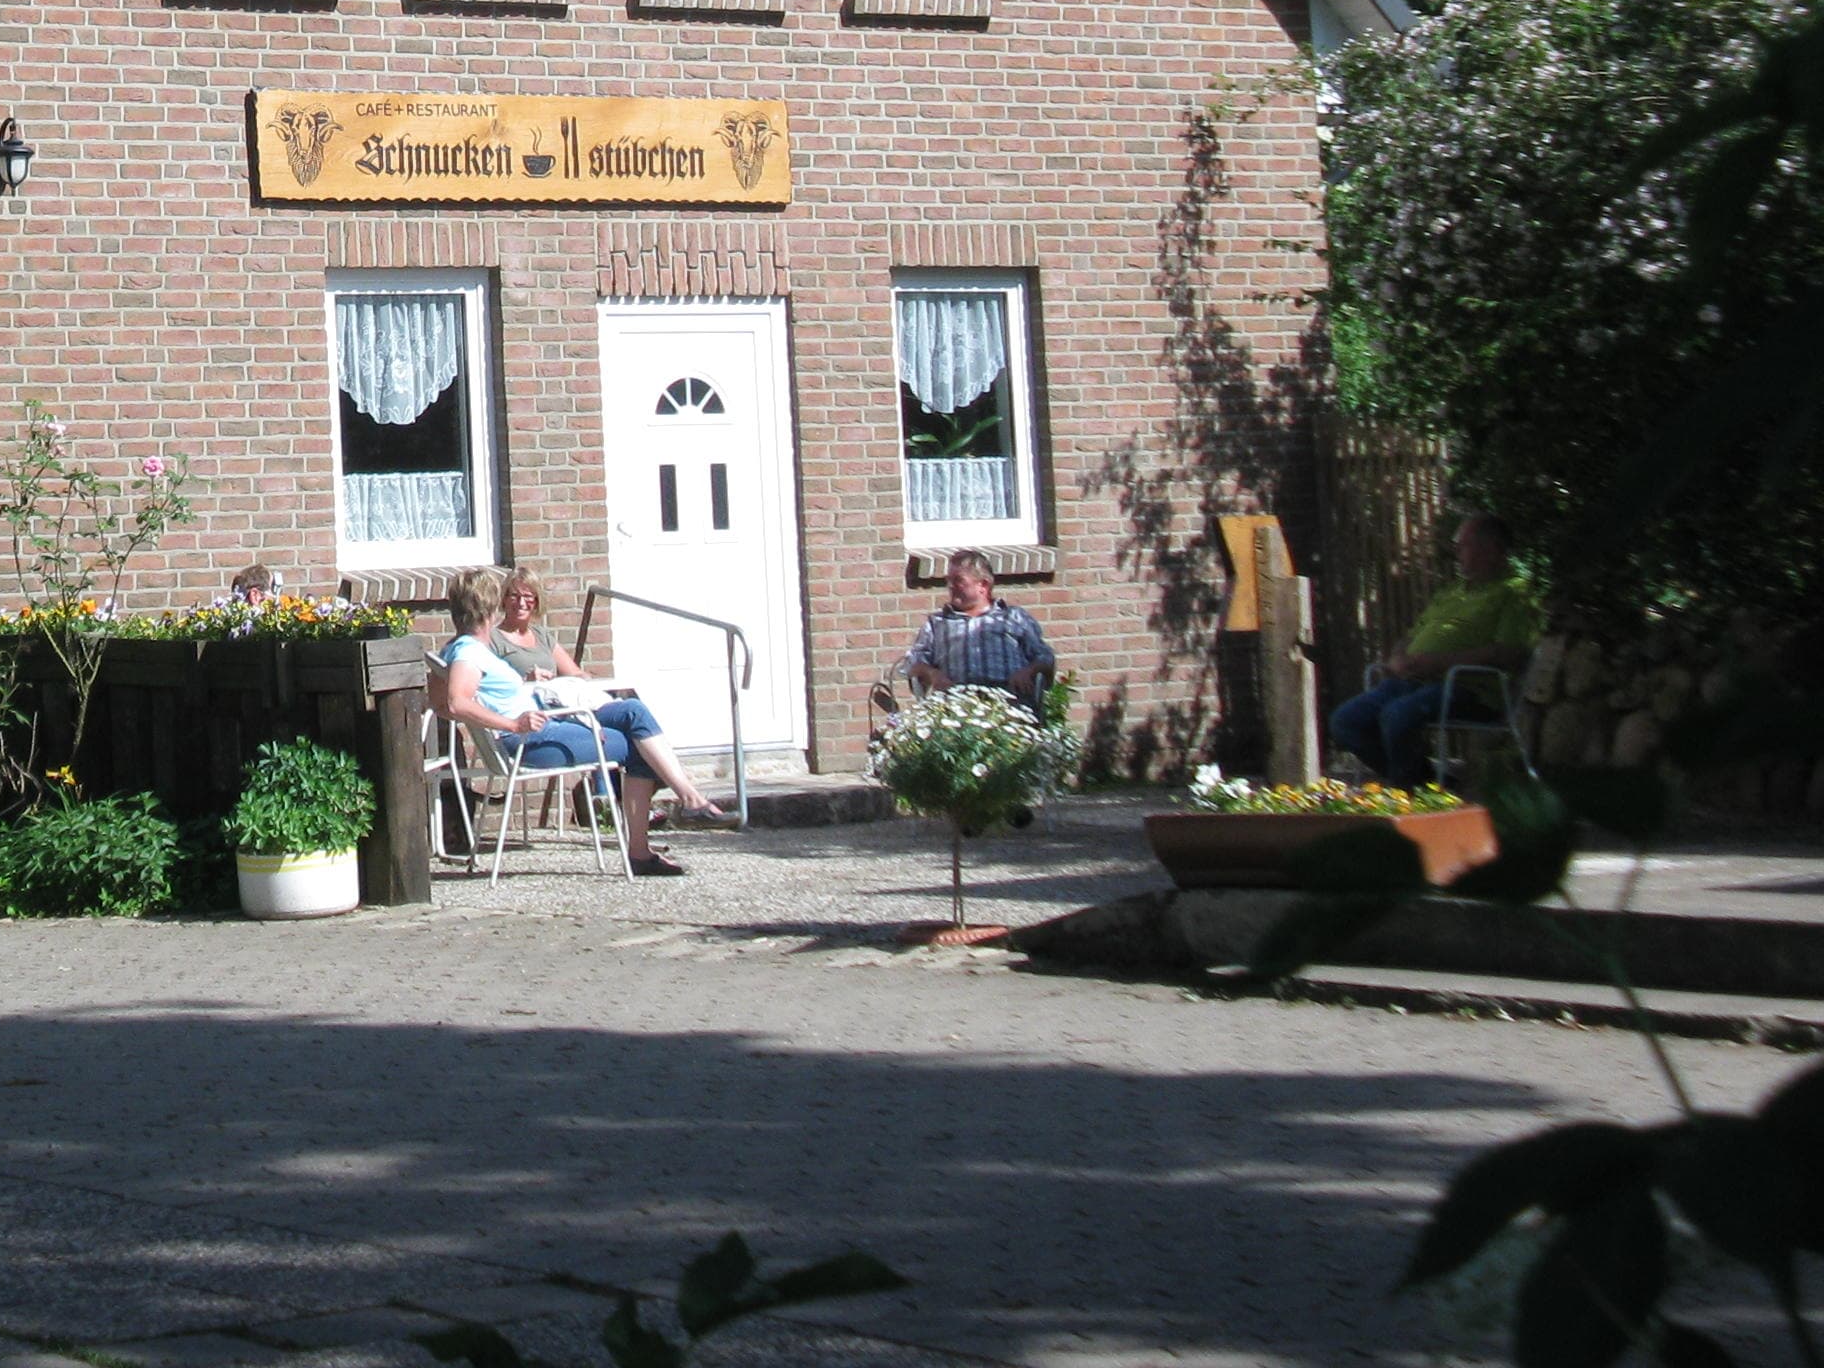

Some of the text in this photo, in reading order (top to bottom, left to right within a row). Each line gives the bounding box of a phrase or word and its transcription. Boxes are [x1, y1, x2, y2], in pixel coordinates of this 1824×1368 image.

[356, 100, 498, 118] CAFÉ+RESTAURANT
[355, 133, 706, 182] Schnucken stübchen
